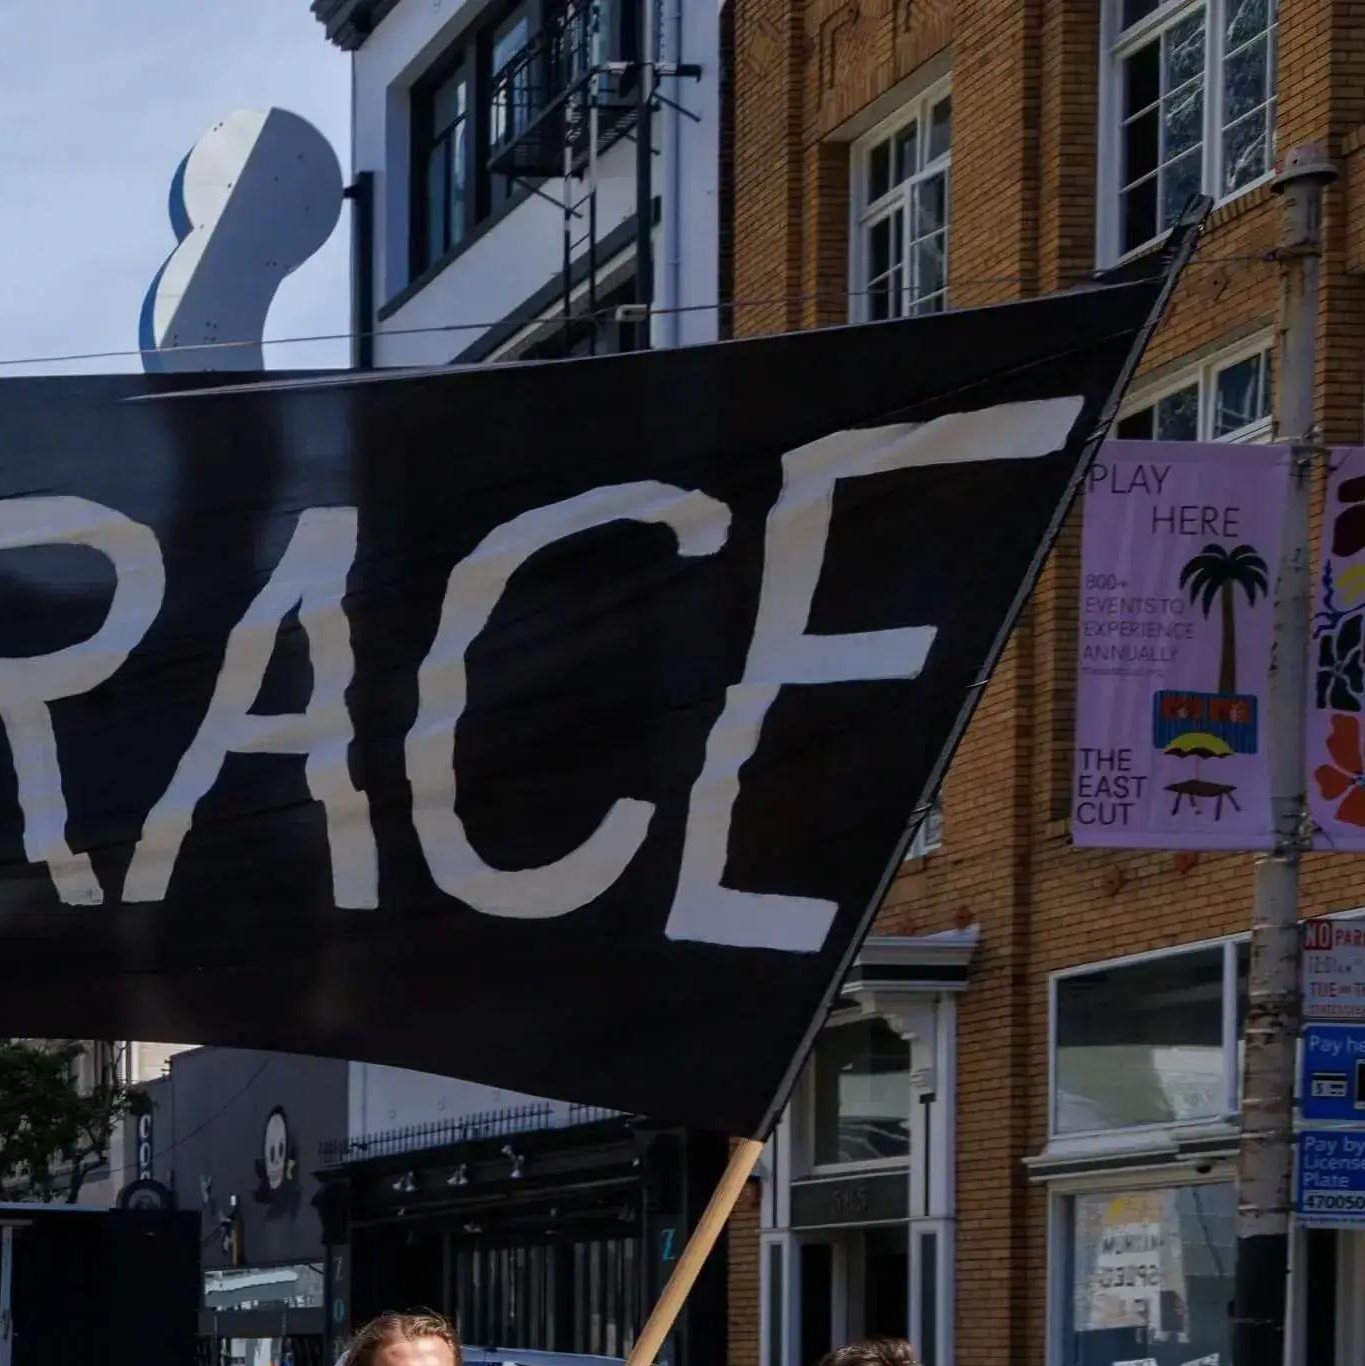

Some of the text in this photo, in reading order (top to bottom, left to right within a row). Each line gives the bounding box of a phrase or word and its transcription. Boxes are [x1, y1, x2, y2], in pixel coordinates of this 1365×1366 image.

[1087, 464, 1171, 495] PLAY
[1152, 506, 1239, 537] HERE
[1083, 622, 1194, 640] EXPERIENCE
[1083, 645, 1179, 661] ANNUALLY
[1082, 749, 1131, 772] THE
[1079, 776, 1147, 798] EAST
[1077, 803, 1134, 825] CUT
[1305, 923, 1365, 949] NO PAR
[1309, 1035, 1341, 1057] Pay
[1305, 1136, 1338, 1157] Pay
[1303, 1155, 1365, 1171] License
[1302, 1172, 1350, 1188] Plate
